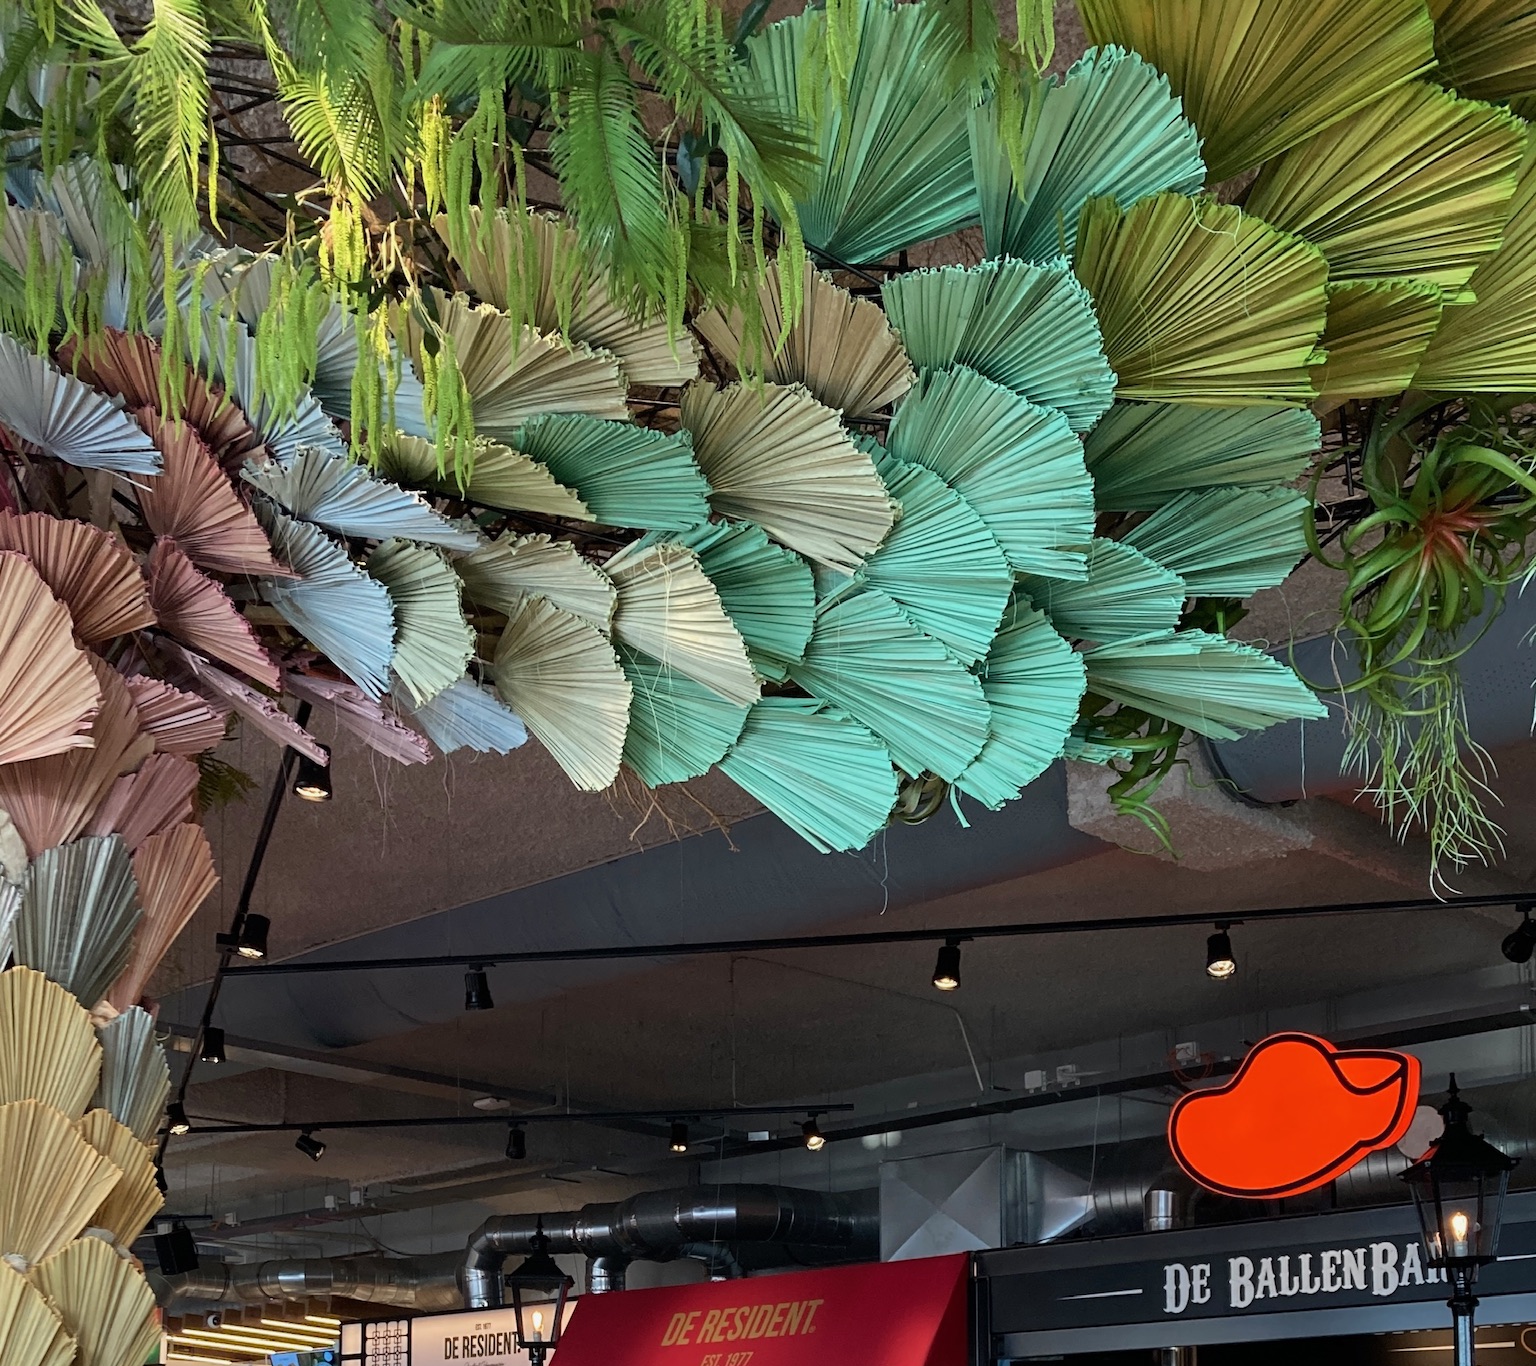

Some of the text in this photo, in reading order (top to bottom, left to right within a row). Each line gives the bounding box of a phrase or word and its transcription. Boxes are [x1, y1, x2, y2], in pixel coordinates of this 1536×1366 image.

[1163, 1262, 1211, 1314] DE
[661, 1310, 702, 1347] DE
[444, 1337, 459, 1360] DE
